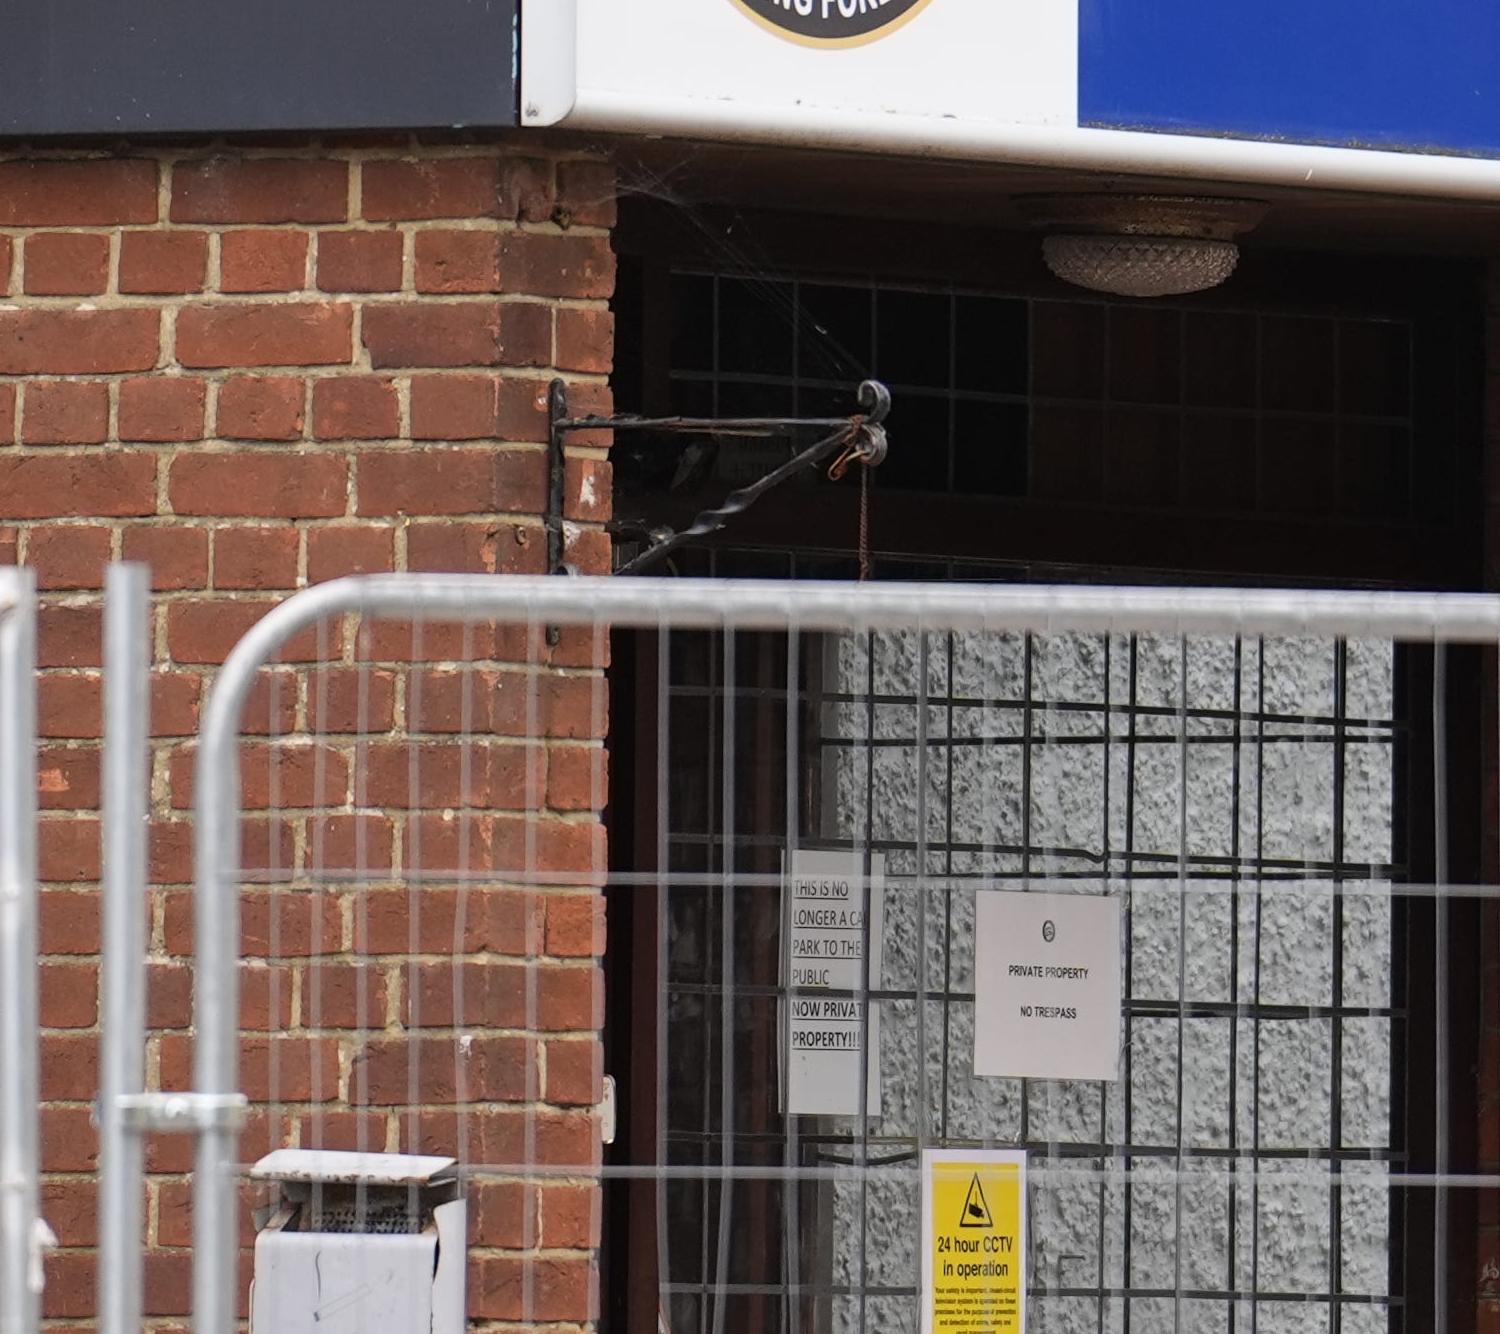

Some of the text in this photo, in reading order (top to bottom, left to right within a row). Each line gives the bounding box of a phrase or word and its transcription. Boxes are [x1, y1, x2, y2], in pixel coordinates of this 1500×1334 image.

[794, 880, 849, 897] THIS IS NO
[793, 910, 837, 926] LONGER
[839, 911, 847, 926] A
[793, 940, 861, 956] PARK TO THE
[792, 969, 830, 985] PUBLIC
[1008, 964, 1089, 979] PRIVATE PROPERTY
[792, 1001, 864, 1018] NOW PRIVAT
[1020, 1005, 1076, 1019] NO TRESPASS
[937, 1236, 1013, 1253] 24 hour CCTV
[943, 1259, 1009, 1280] in operation
